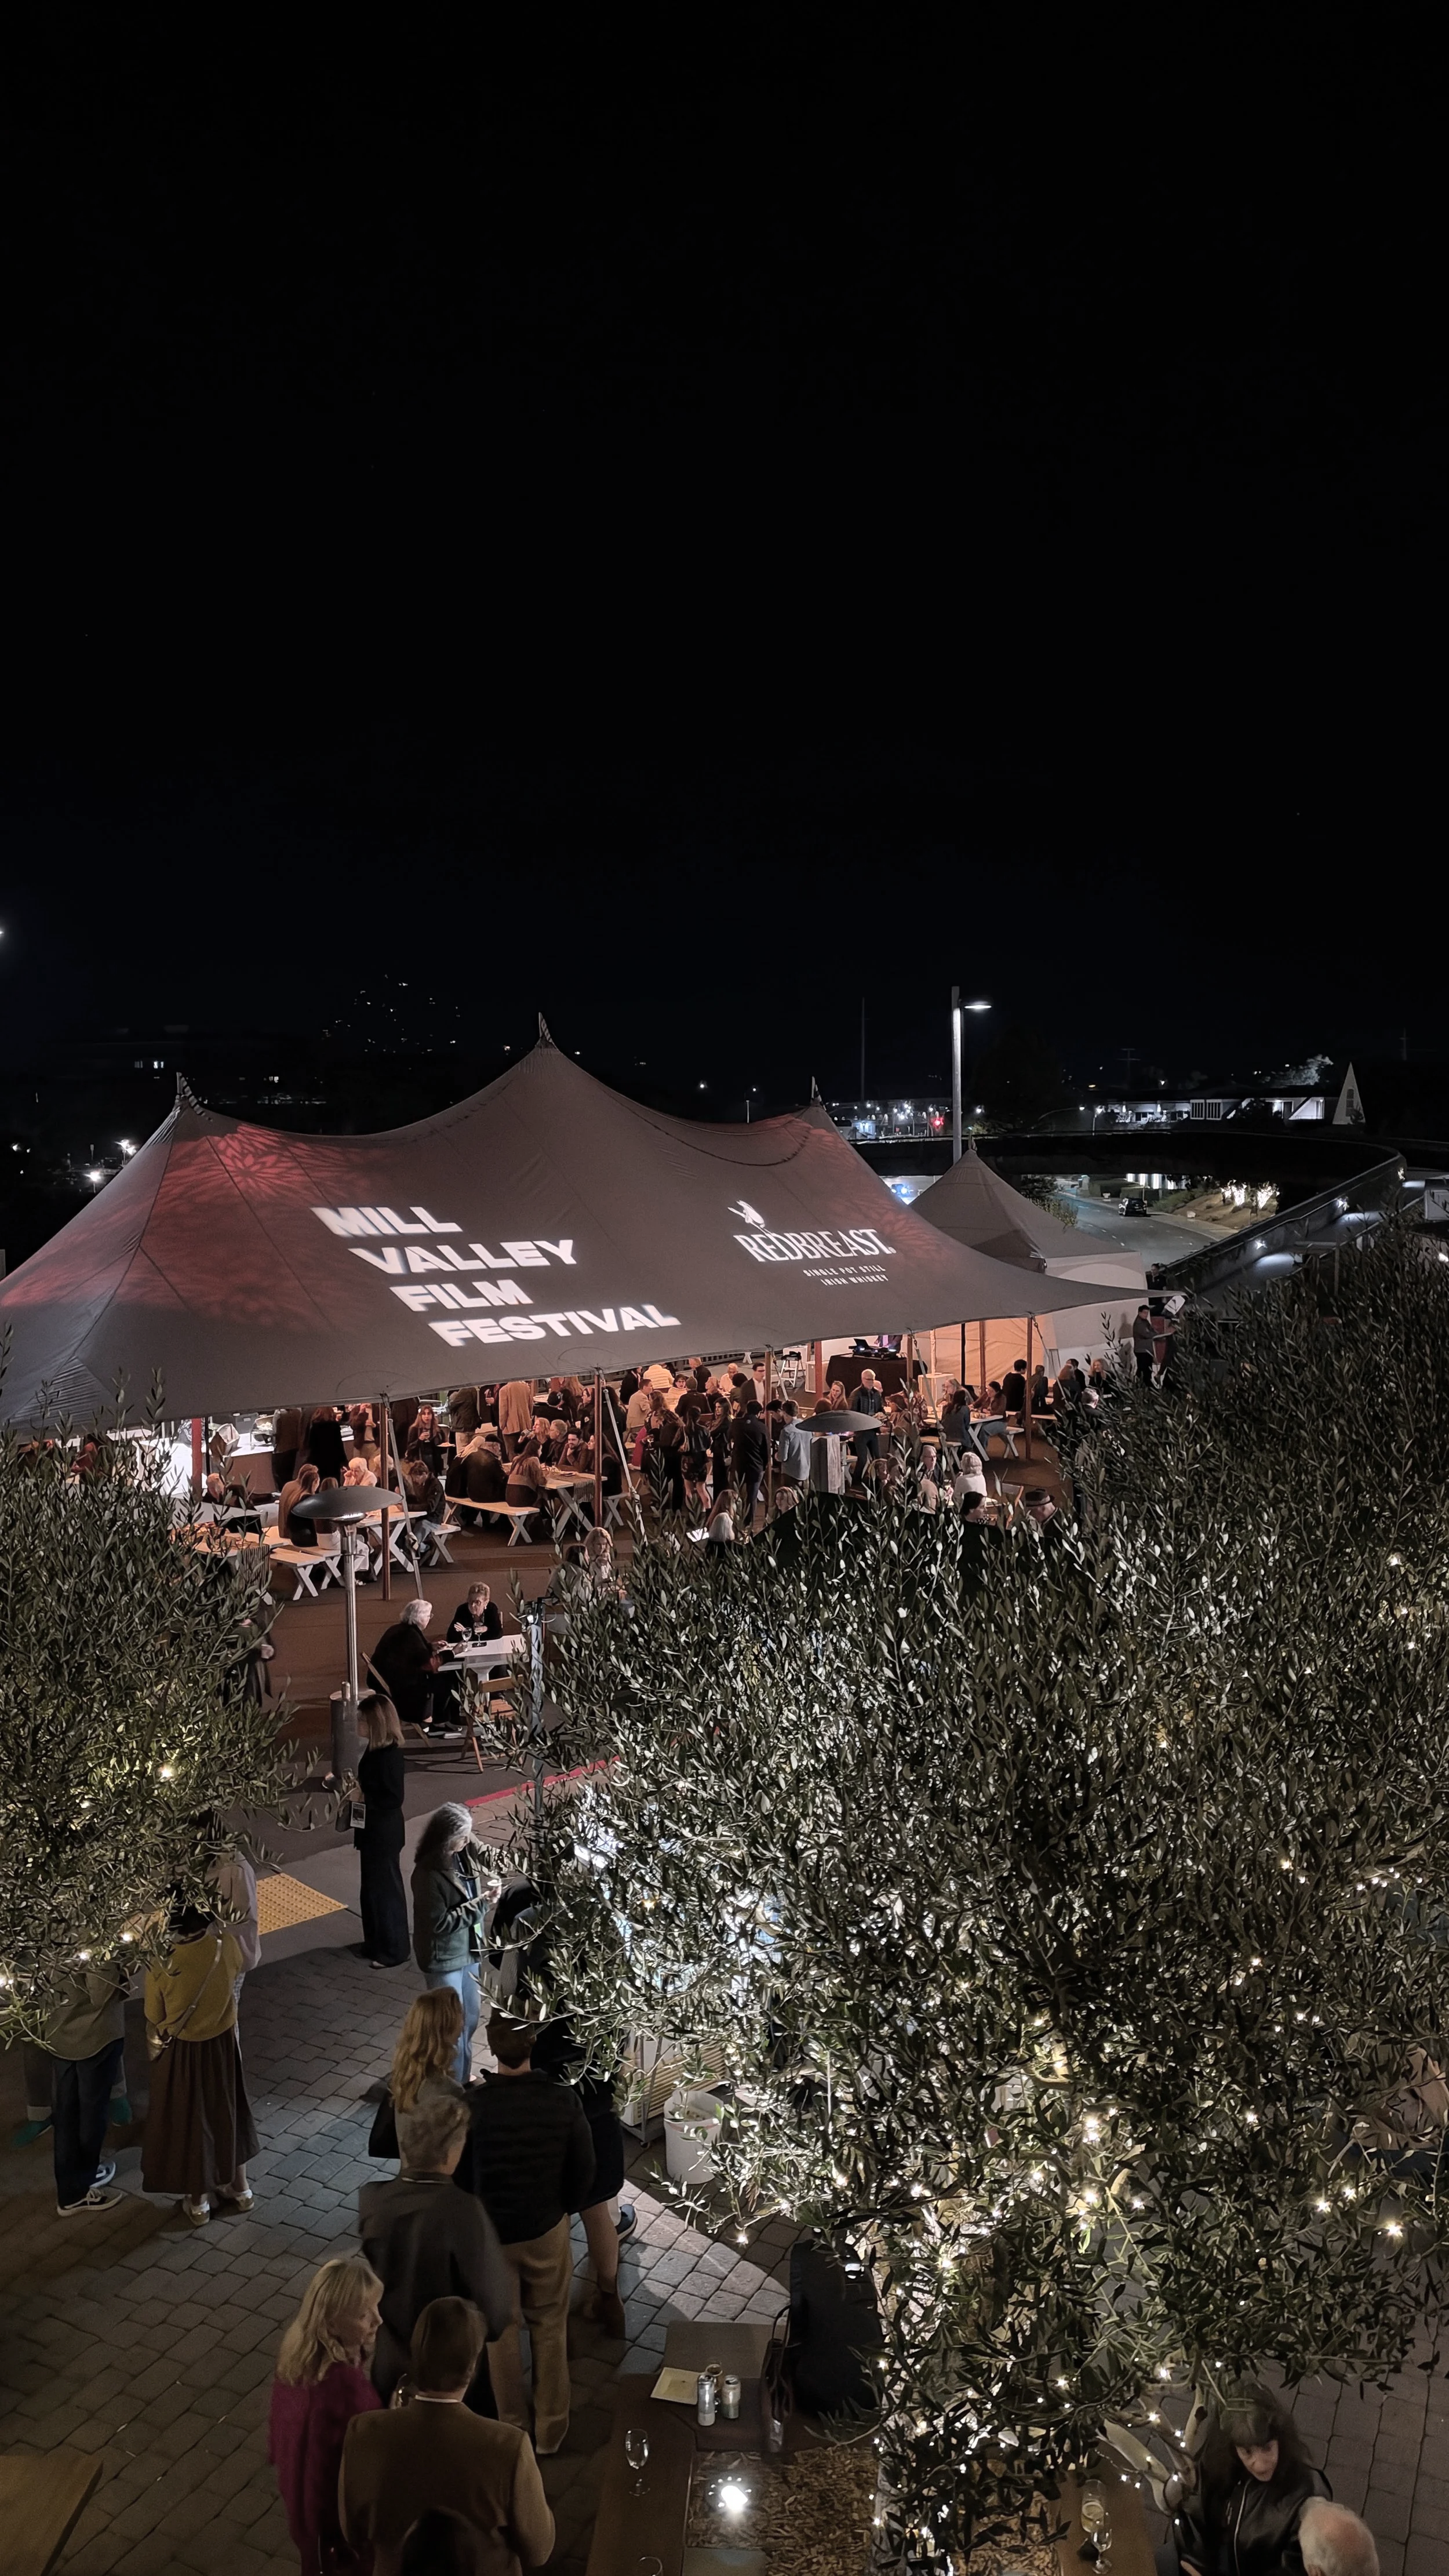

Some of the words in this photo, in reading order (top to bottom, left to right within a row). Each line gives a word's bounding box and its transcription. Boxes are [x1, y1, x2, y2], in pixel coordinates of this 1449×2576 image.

[312, 1206, 463, 1236] MILL
[348, 1239, 577, 1274] VALLEY
[803, 1268, 839, 1276] SINGLE
[858, 1265, 886, 1273] STILL
[389, 1279, 533, 1312] FILM
[820, 1278, 849, 1286] IRISH
[848, 1275, 889, 1283] WHISKEY
[428, 1304, 682, 1347] FESTIVAL
